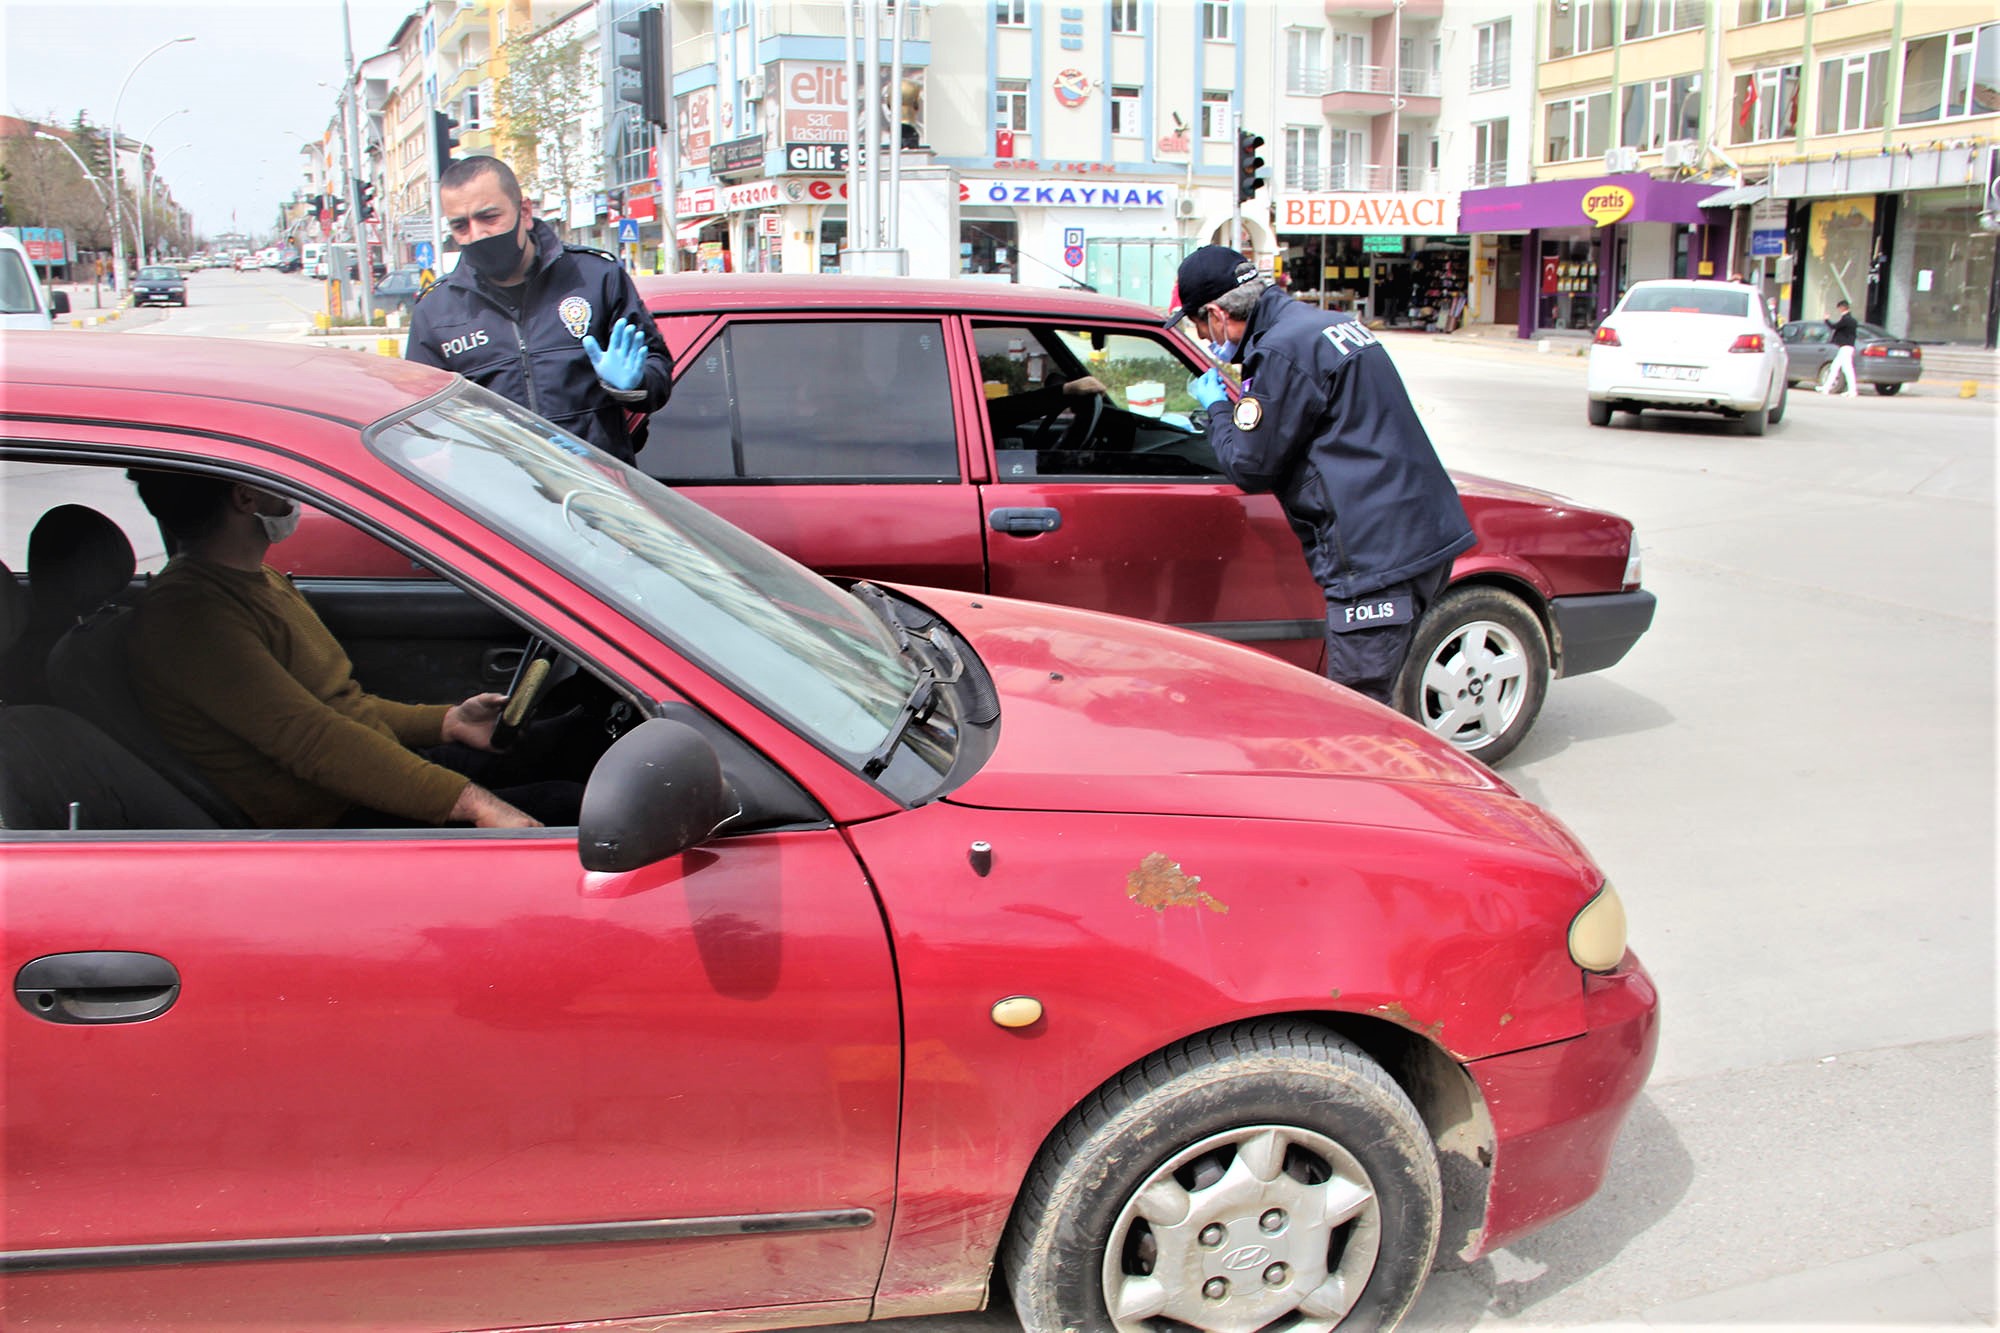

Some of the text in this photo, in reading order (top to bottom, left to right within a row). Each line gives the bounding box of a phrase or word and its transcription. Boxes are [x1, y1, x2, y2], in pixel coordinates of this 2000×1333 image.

[790, 66, 848, 105] elit
[1159, 135, 1190, 153] elit
[790, 146, 835, 168] elit
[989, 181, 1164, 205] ÖZKAYNAK
[1588, 191, 1625, 212] gratis
[1285, 199, 1445, 227] BEDAVACI
[766, 219, 777, 232] E
